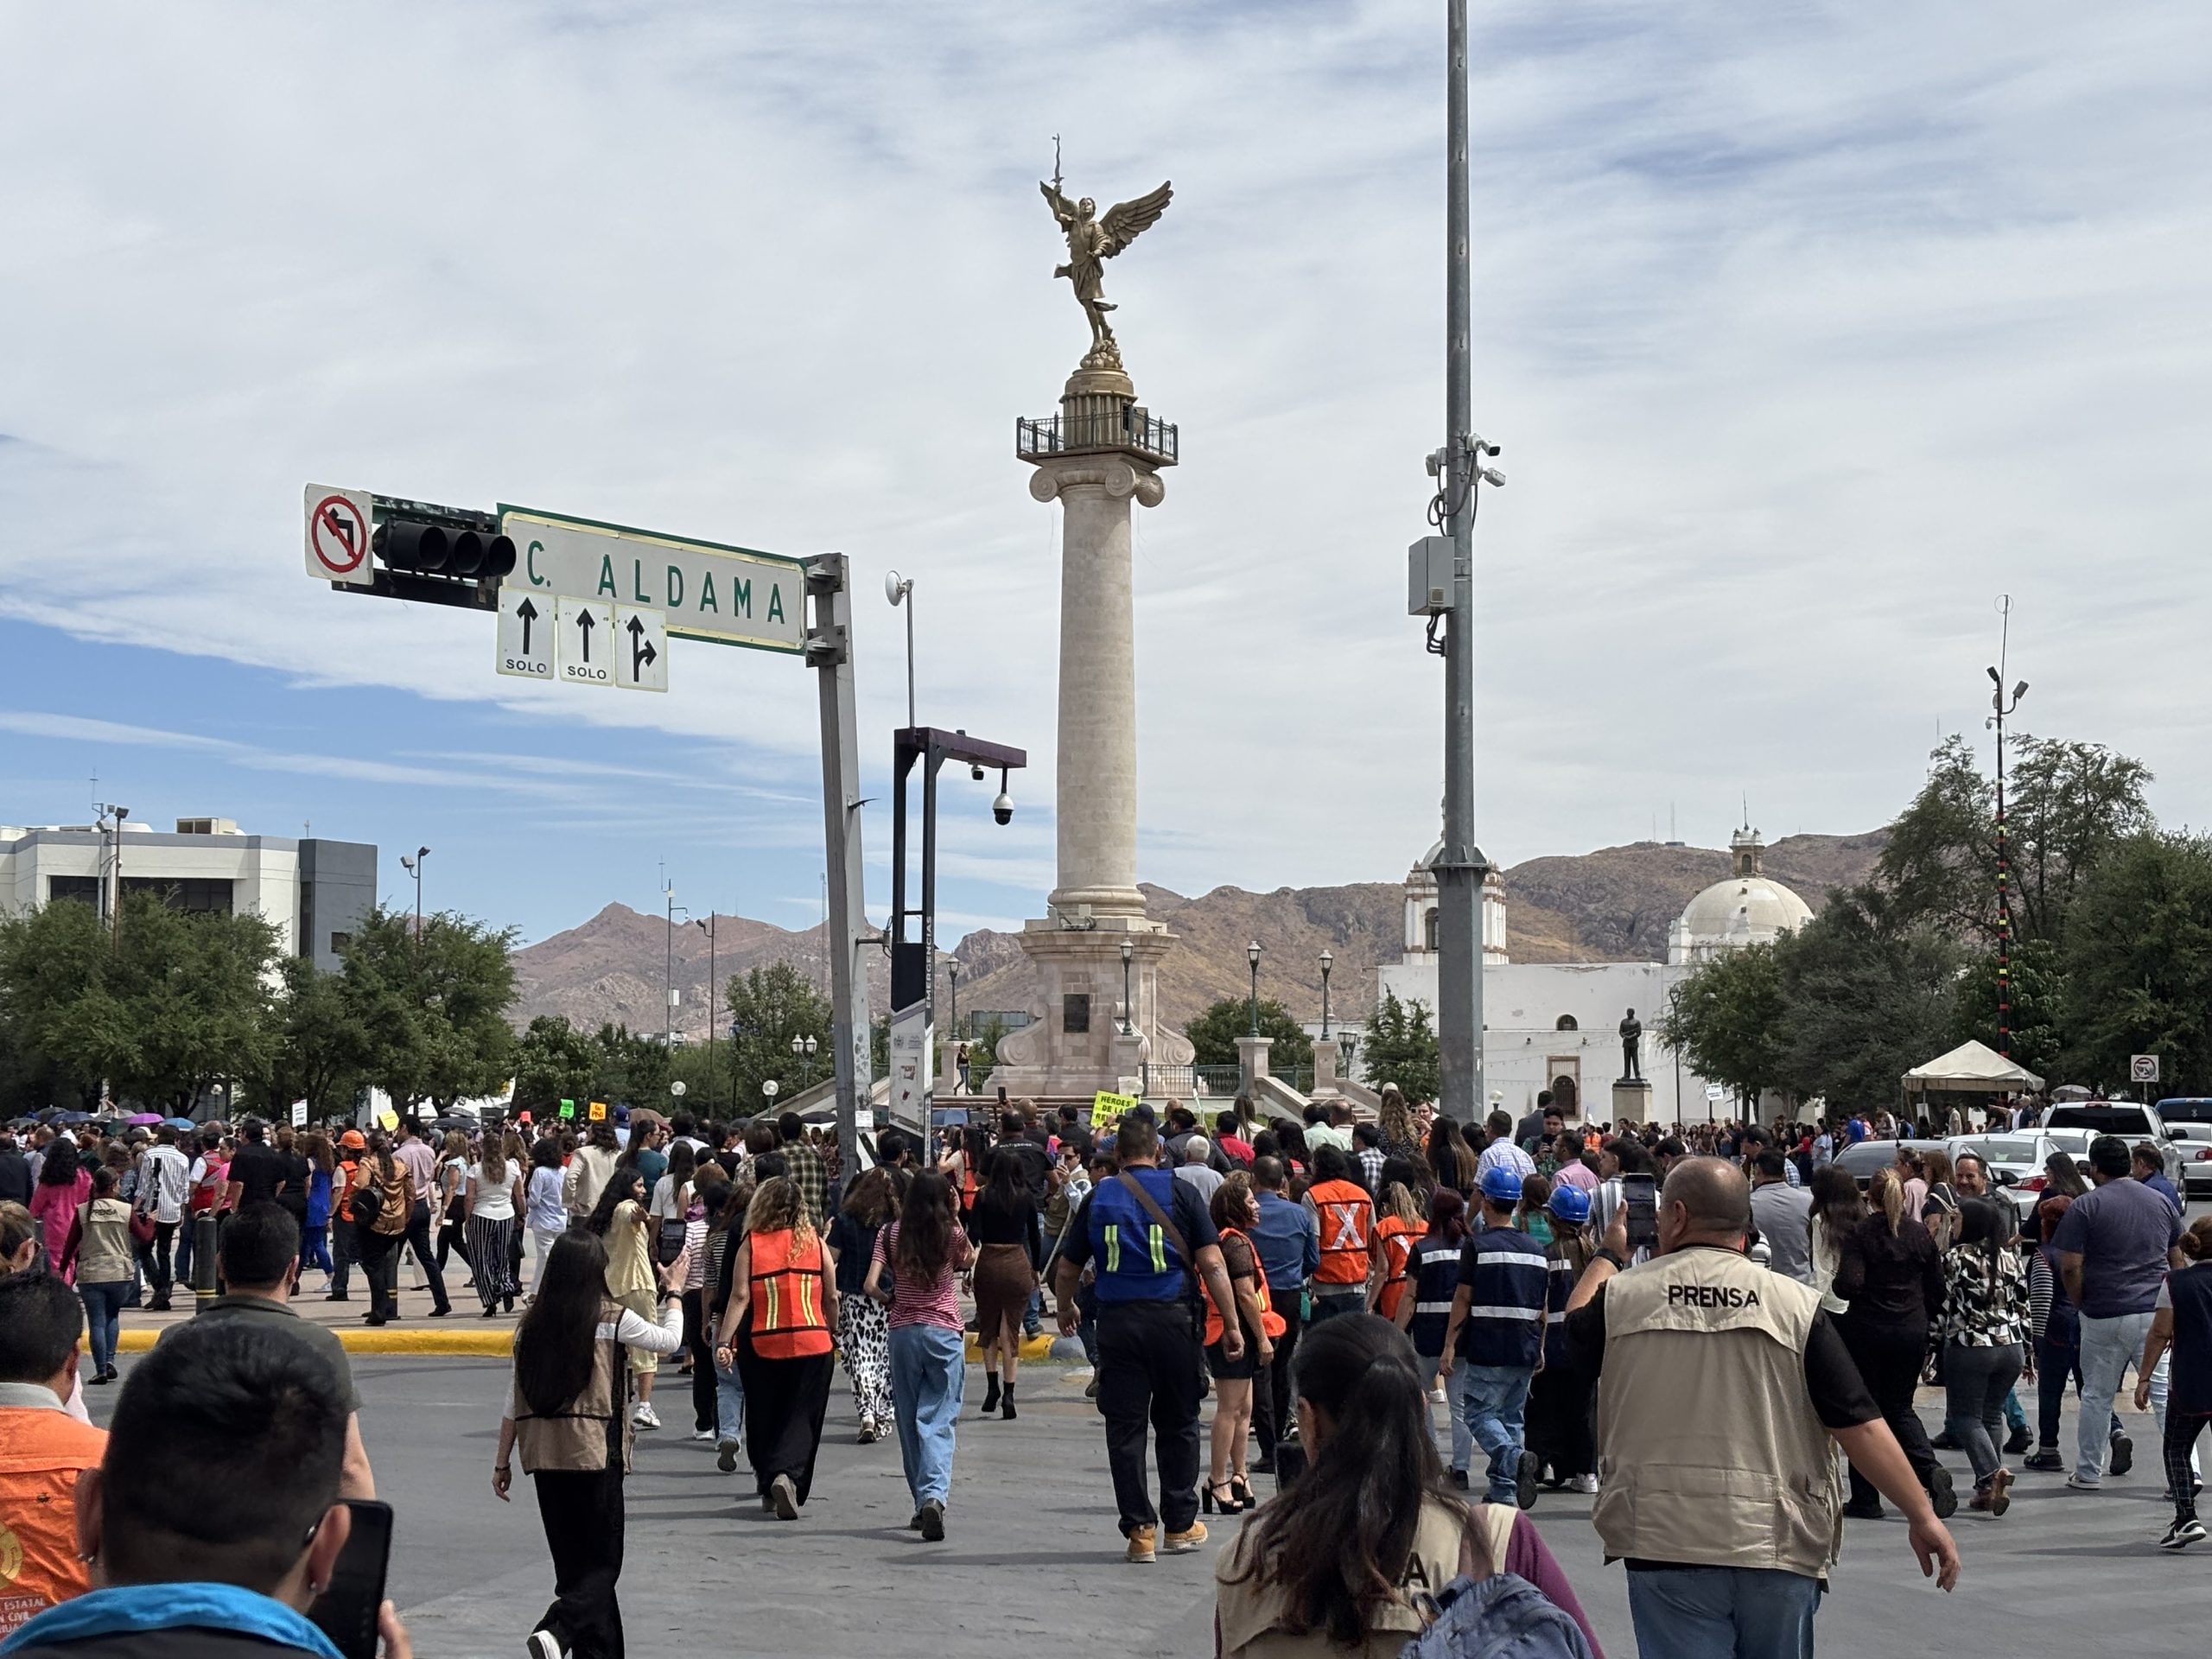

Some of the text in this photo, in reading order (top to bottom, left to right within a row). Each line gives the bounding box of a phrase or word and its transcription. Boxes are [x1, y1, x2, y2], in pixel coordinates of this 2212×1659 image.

[527, 540, 785, 626] C. ALDAMA
[505, 658, 547, 674] SOLO
[567, 665, 607, 681] SOLO
[1669, 1285, 1760, 1308] PRENSA
[4, 1598, 46, 1611] ESTATAL
